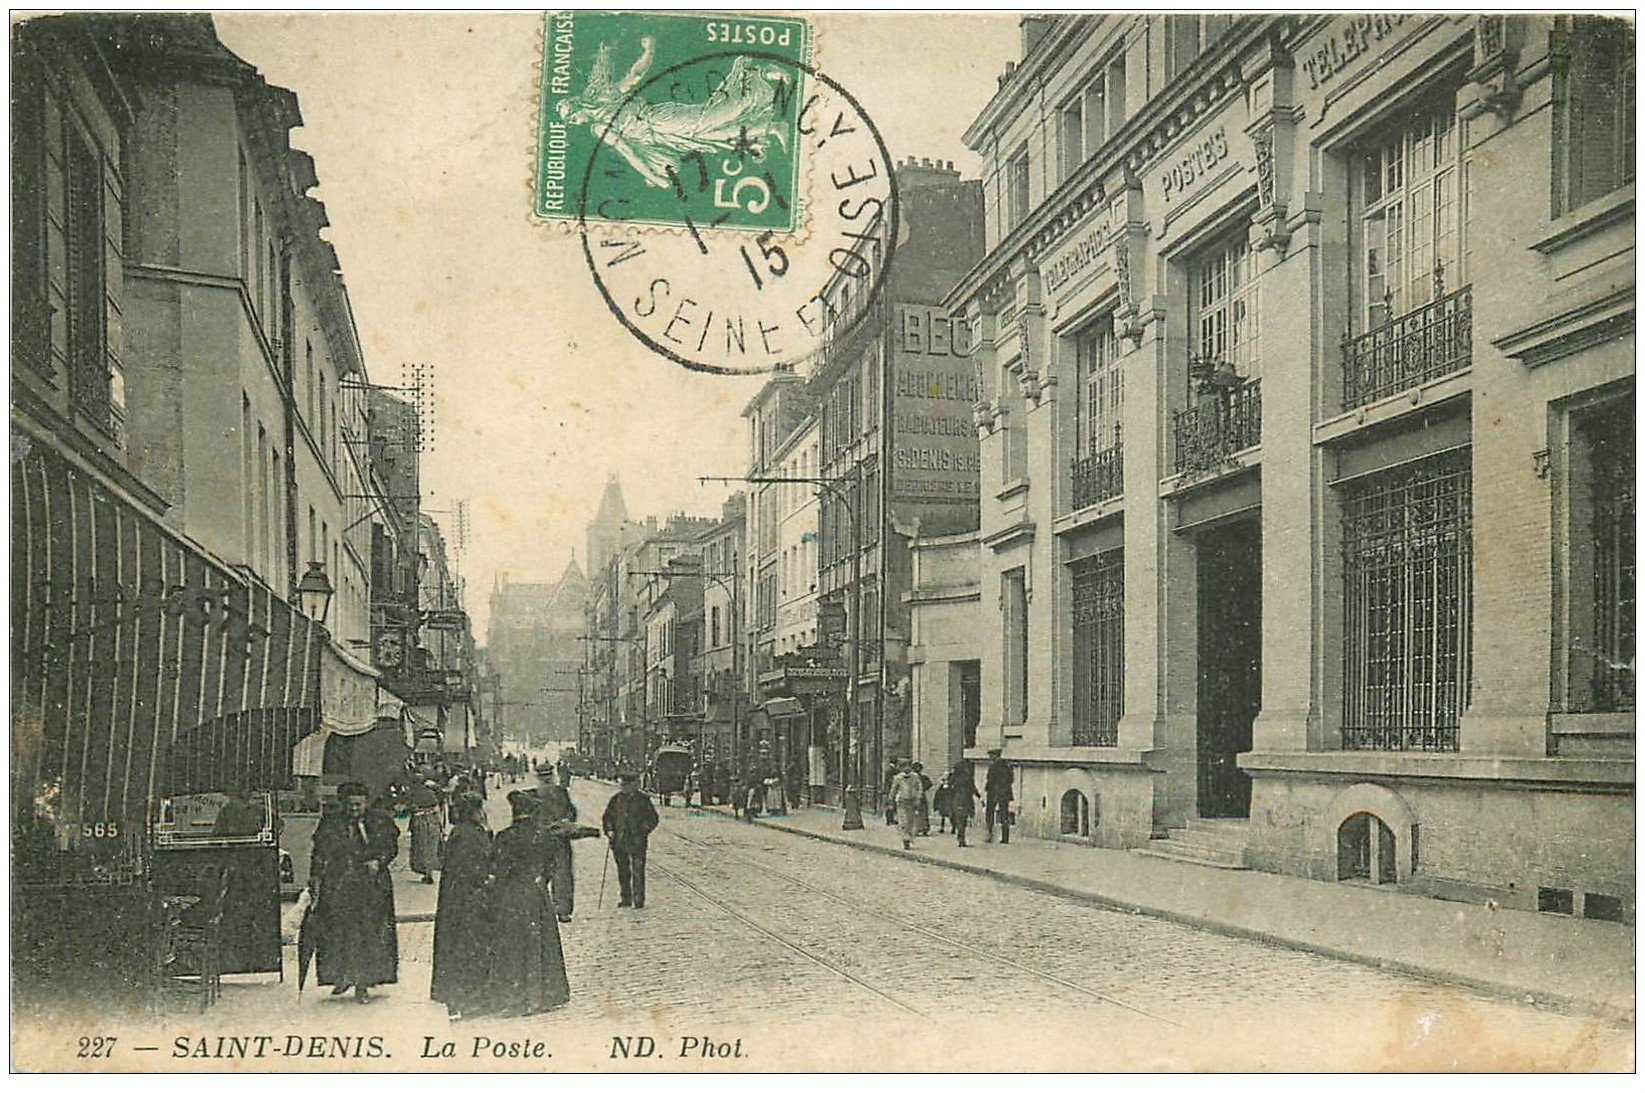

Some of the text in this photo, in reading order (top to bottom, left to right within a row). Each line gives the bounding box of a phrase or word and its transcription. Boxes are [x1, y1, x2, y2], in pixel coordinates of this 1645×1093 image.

[706, 22, 792, 47] POSTES
[545, 121, 567, 211] REPUBLIQUE
[1162, 126, 1228, 202] POSTES
[634, 277, 783, 356] SEINE
[829, 158, 885, 278] OISE
[739, 230, 790, 291] 15
[82, 822, 118, 838] 565
